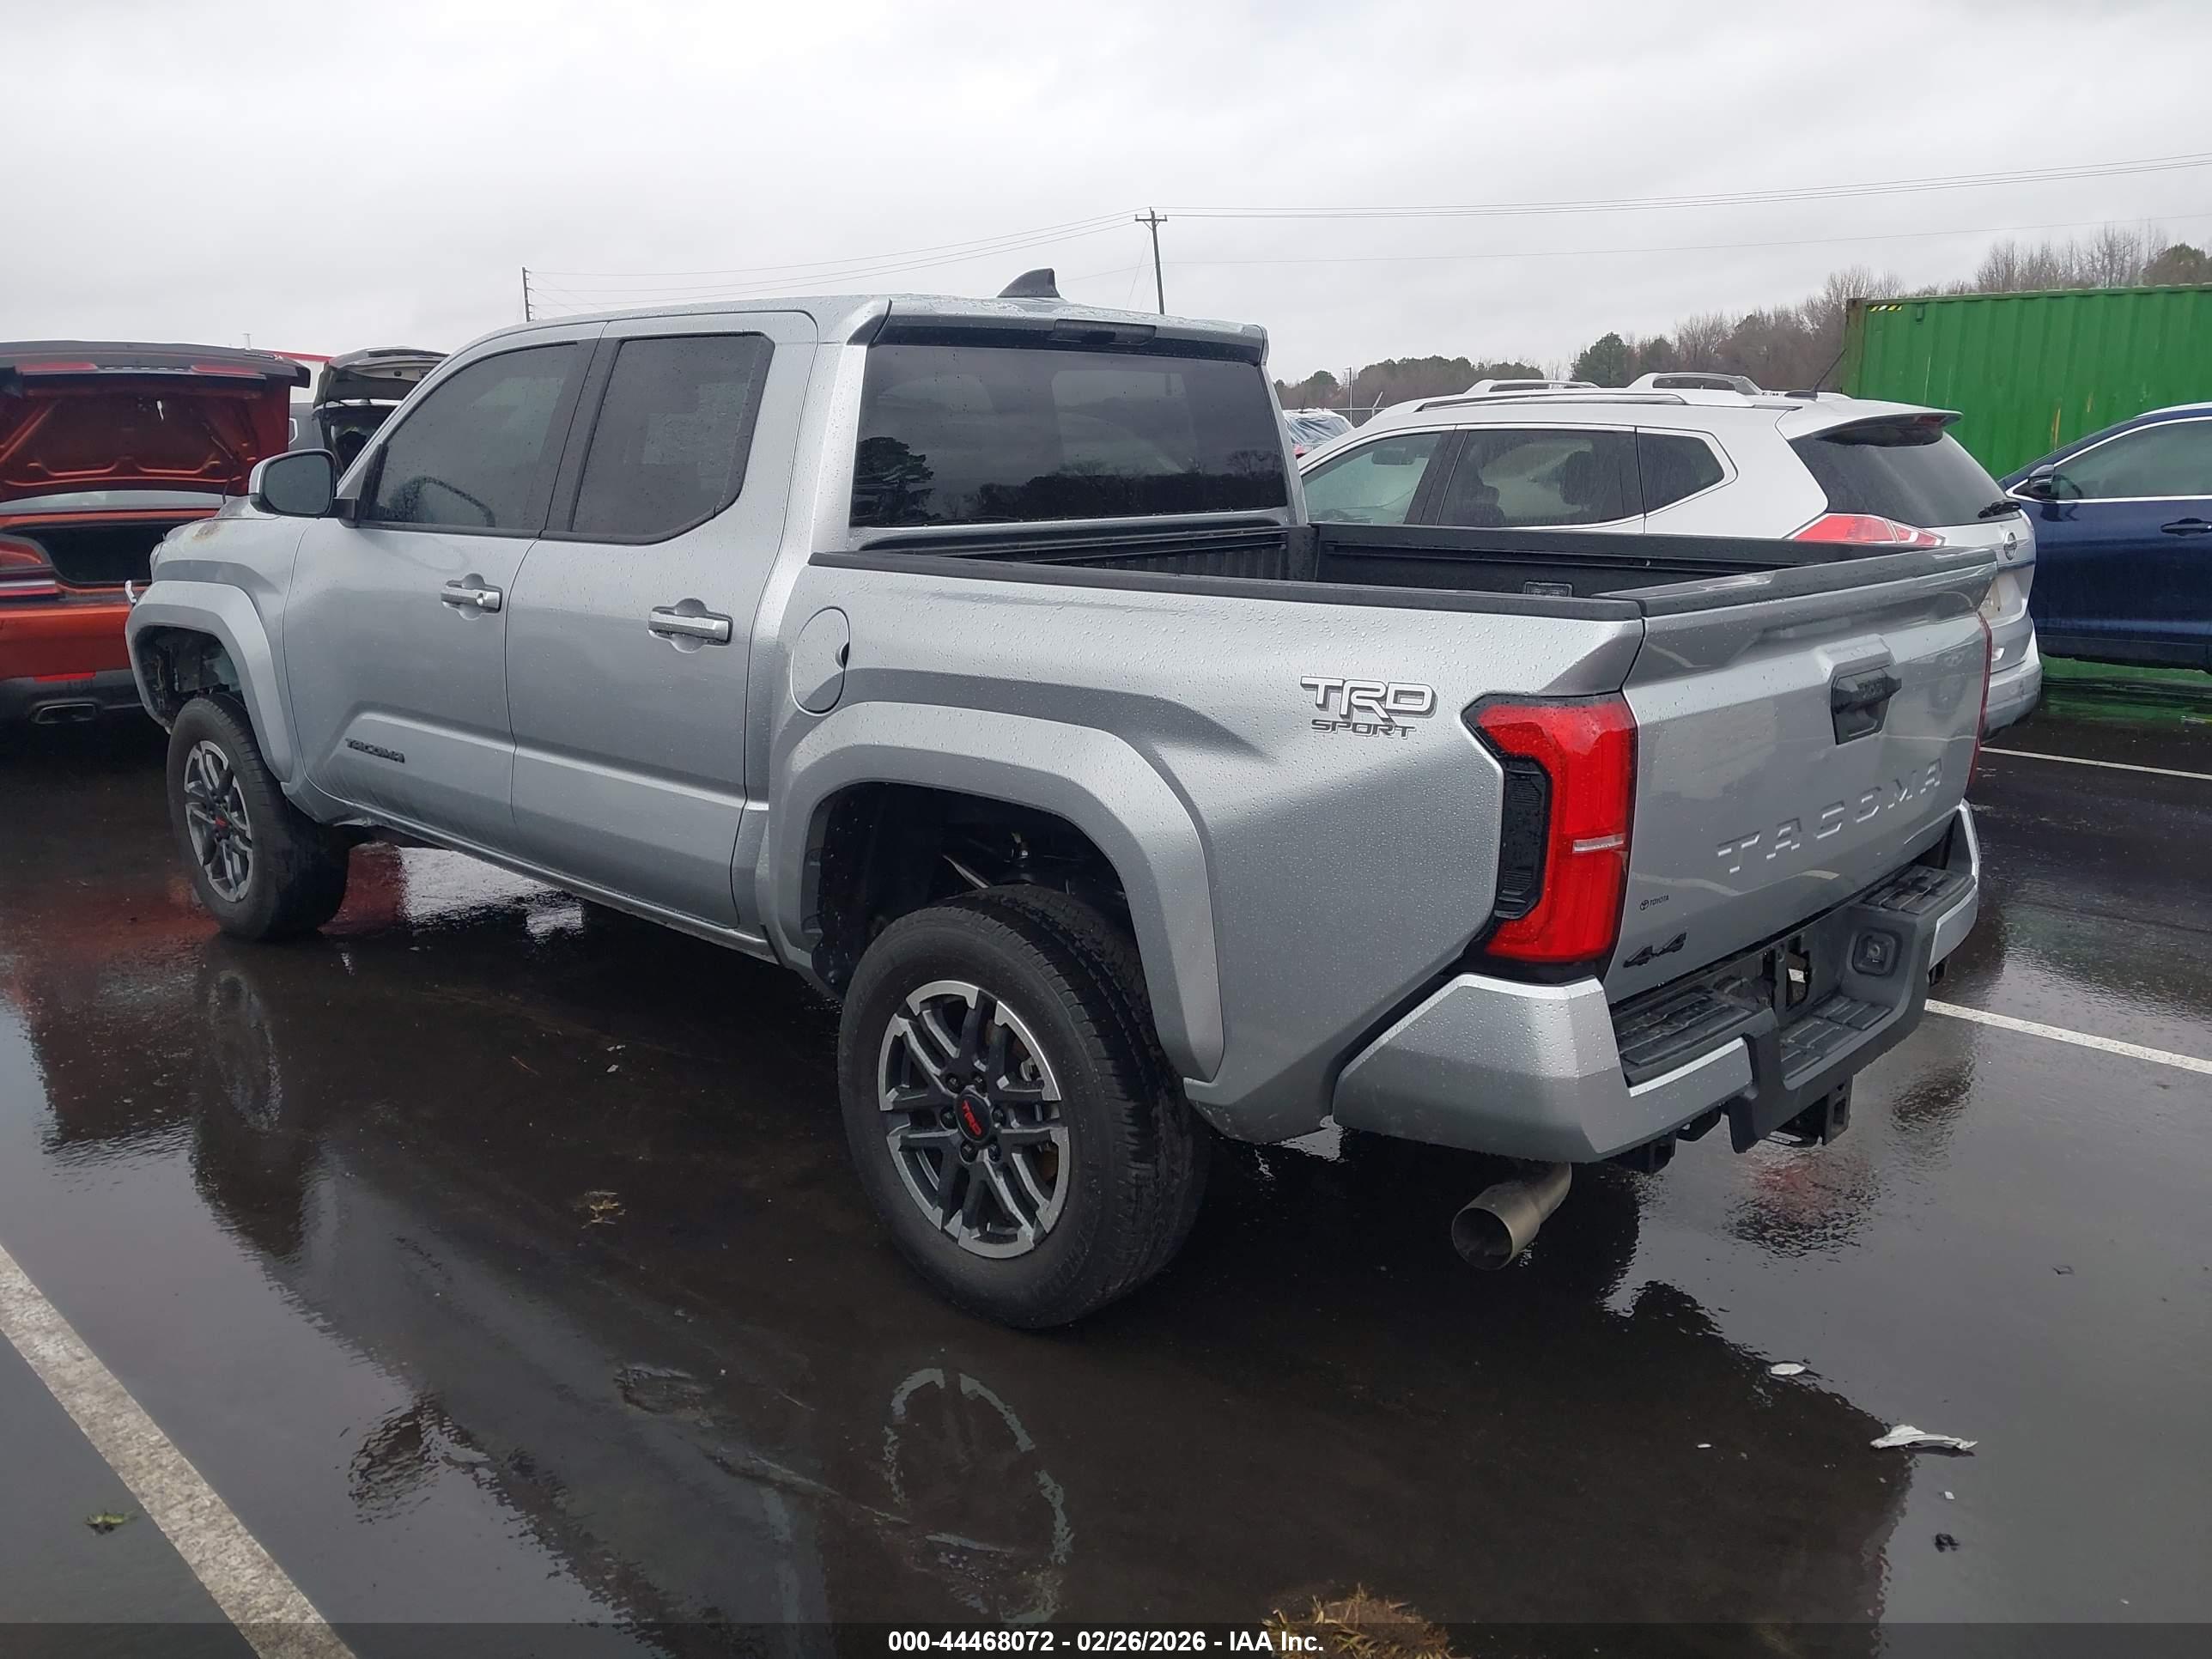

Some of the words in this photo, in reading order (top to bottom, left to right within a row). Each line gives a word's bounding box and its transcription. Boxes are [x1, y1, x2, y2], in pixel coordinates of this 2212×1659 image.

[1300, 676, 1437, 721] TRD
[1311, 719, 1417, 738] SPORT
[345, 738, 405, 763] TACOMA
[1717, 758, 1942, 874] TACOMA
